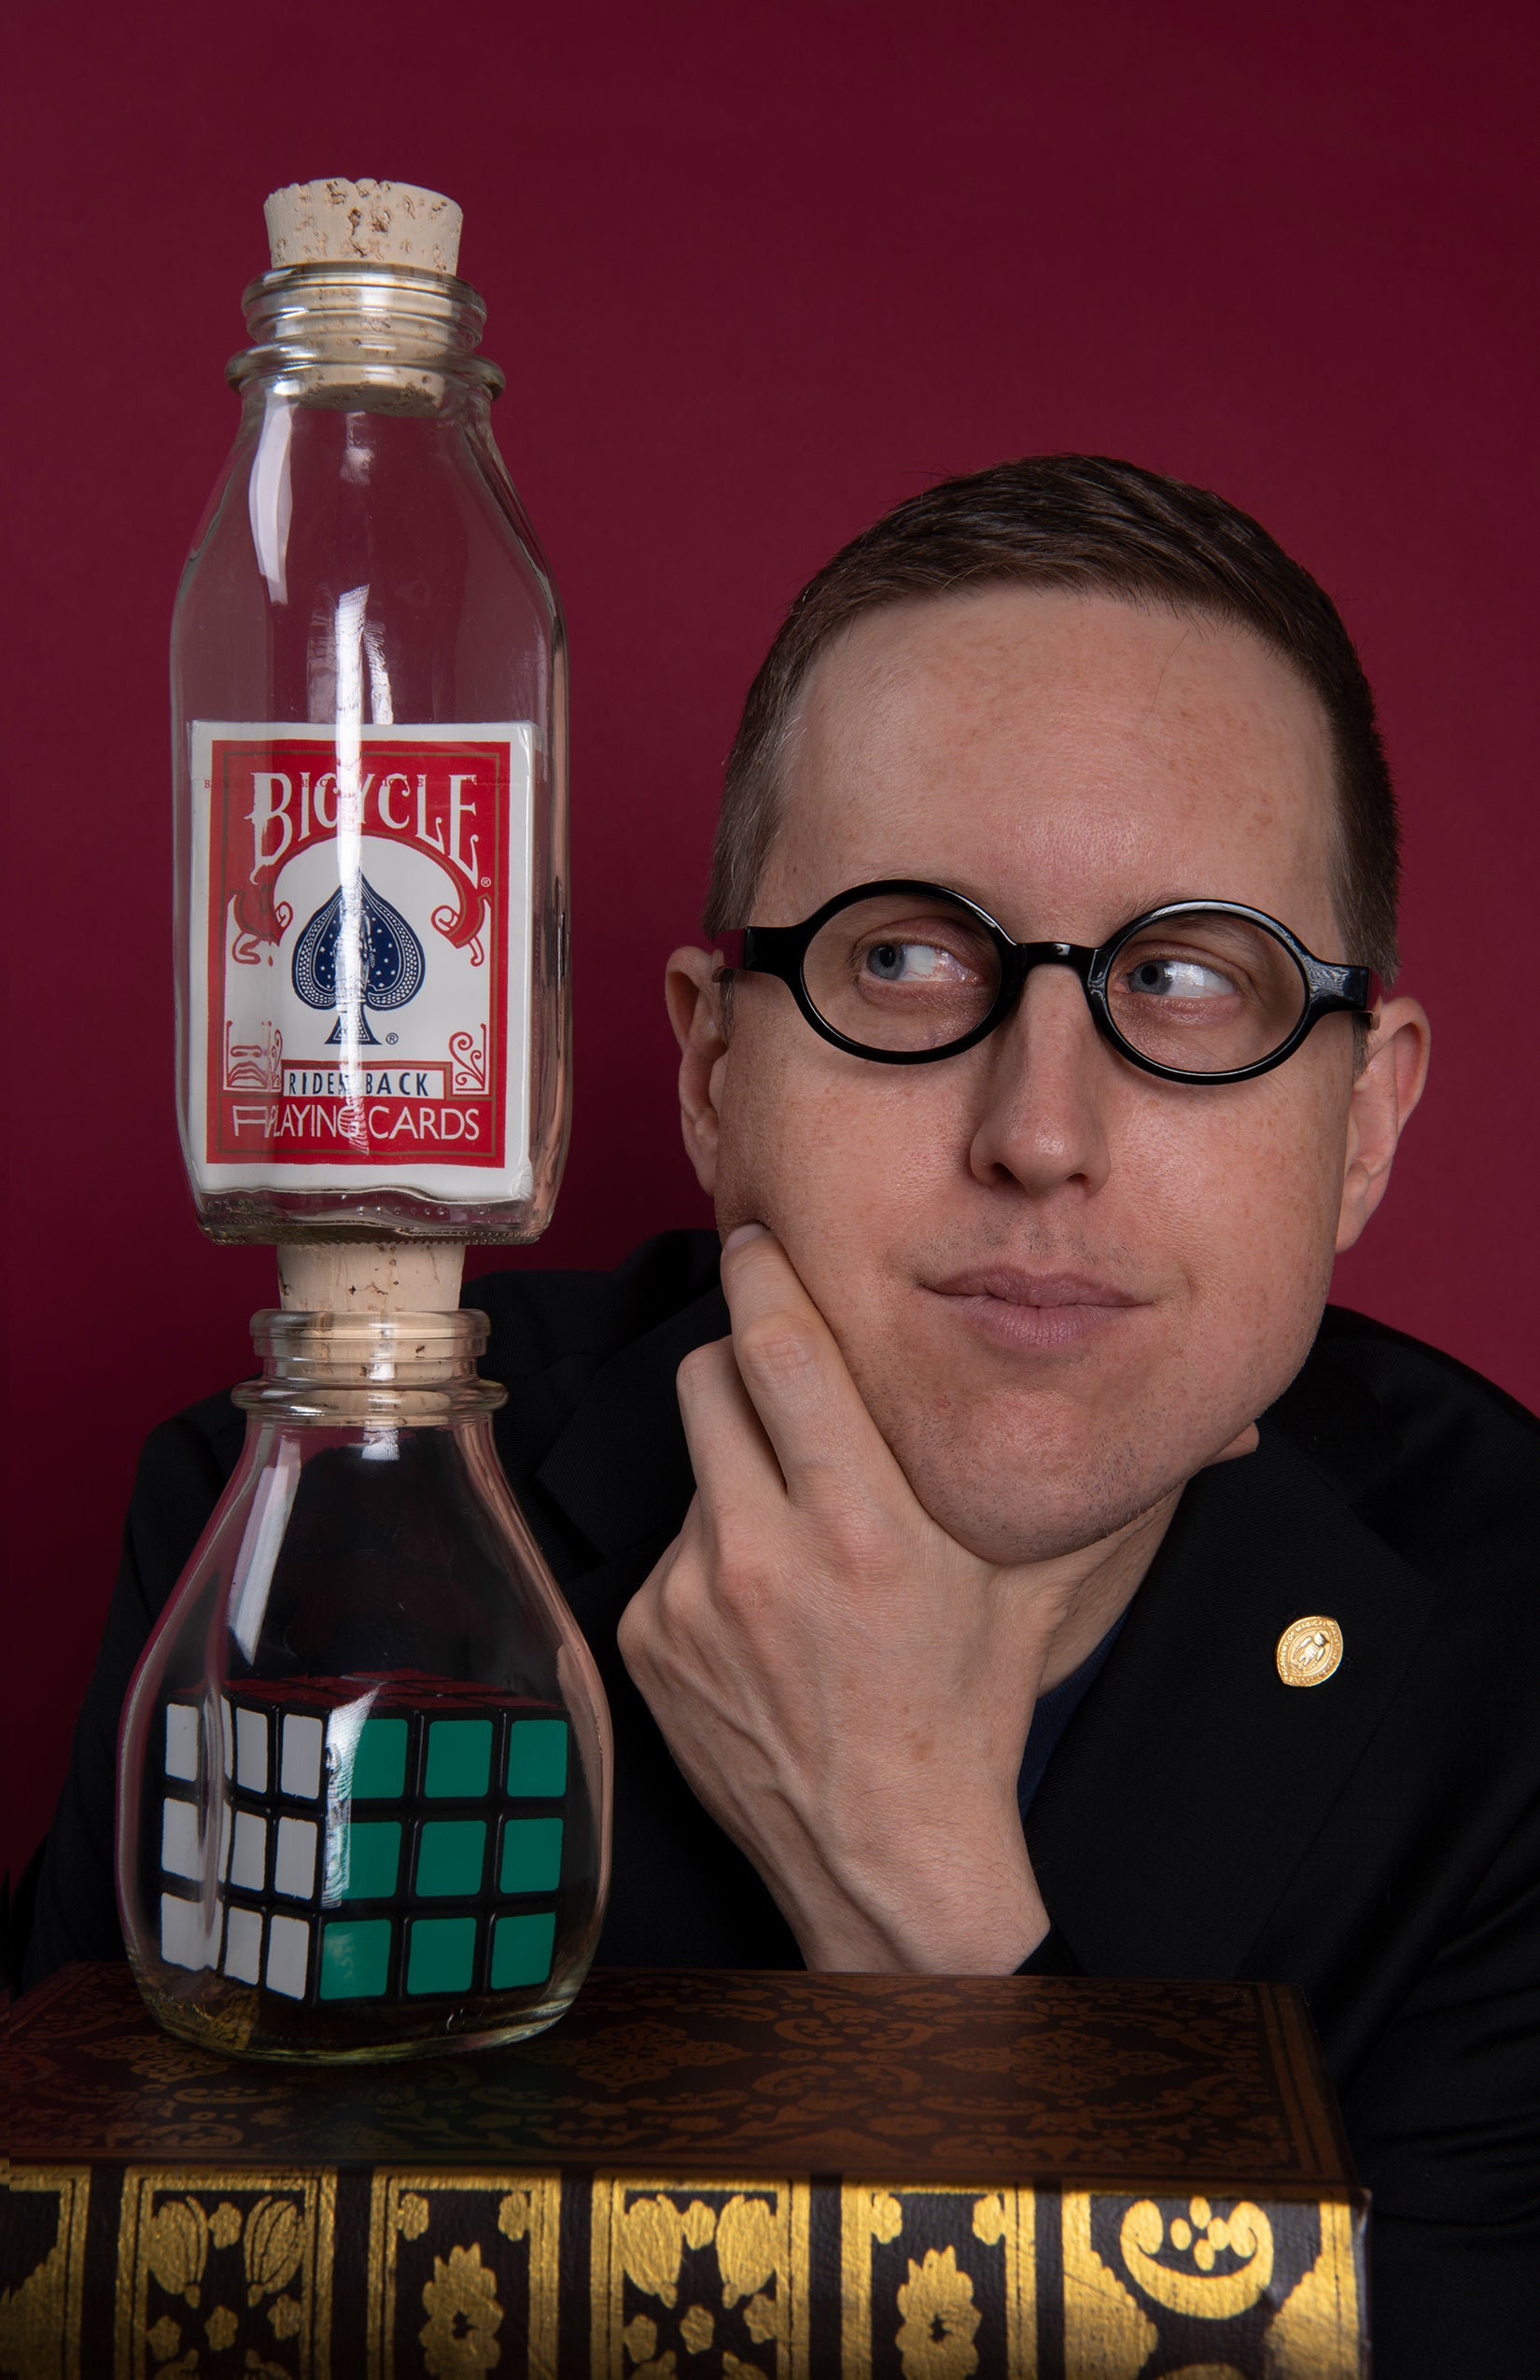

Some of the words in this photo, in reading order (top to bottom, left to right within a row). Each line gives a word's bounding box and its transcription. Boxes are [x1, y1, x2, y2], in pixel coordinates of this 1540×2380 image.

[244, 772, 478, 889] BICYCLE
[366, 1072, 428, 1097] BACK
[369, 1105, 480, 1140] CARDS
